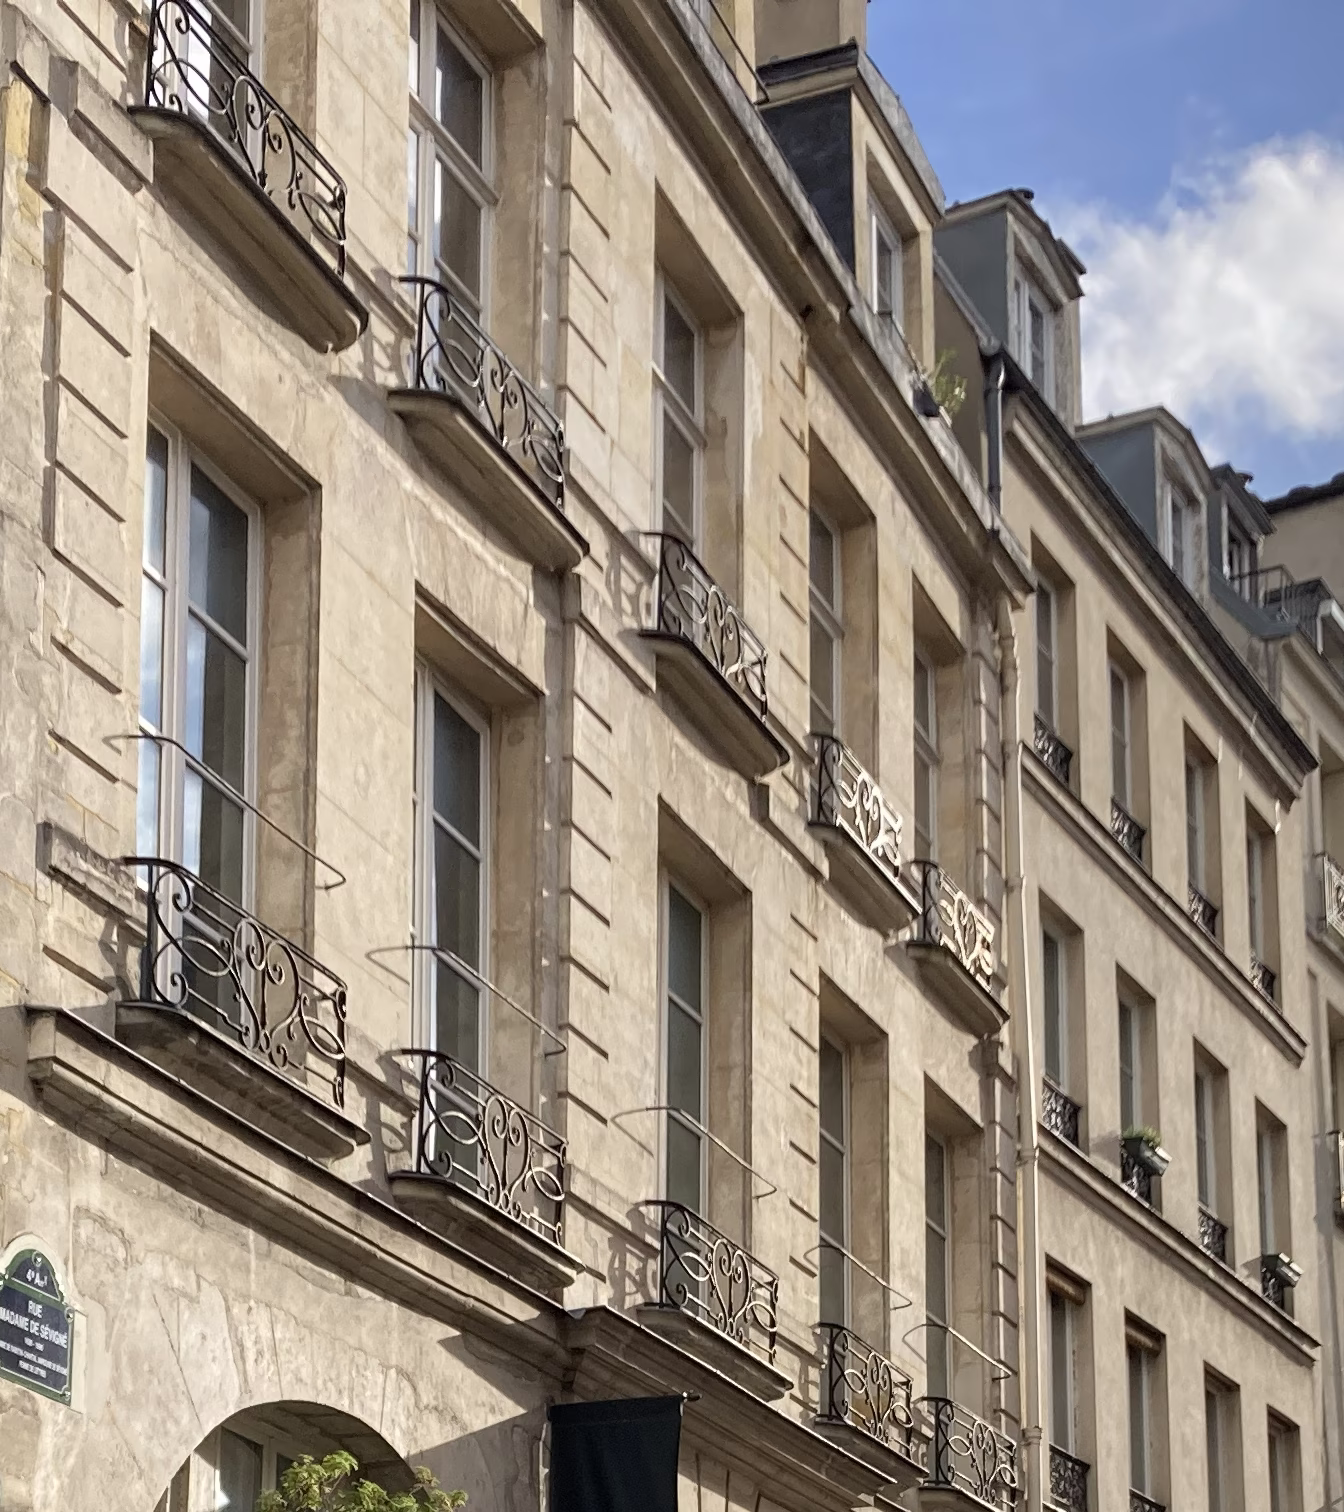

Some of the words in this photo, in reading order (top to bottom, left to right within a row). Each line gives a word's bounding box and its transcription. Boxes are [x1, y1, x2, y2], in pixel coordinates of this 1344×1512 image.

[0, 1306, 29, 1332] MADAME
[30, 1320, 40, 1336] DE
[28, 1300, 42, 1318] RUE
